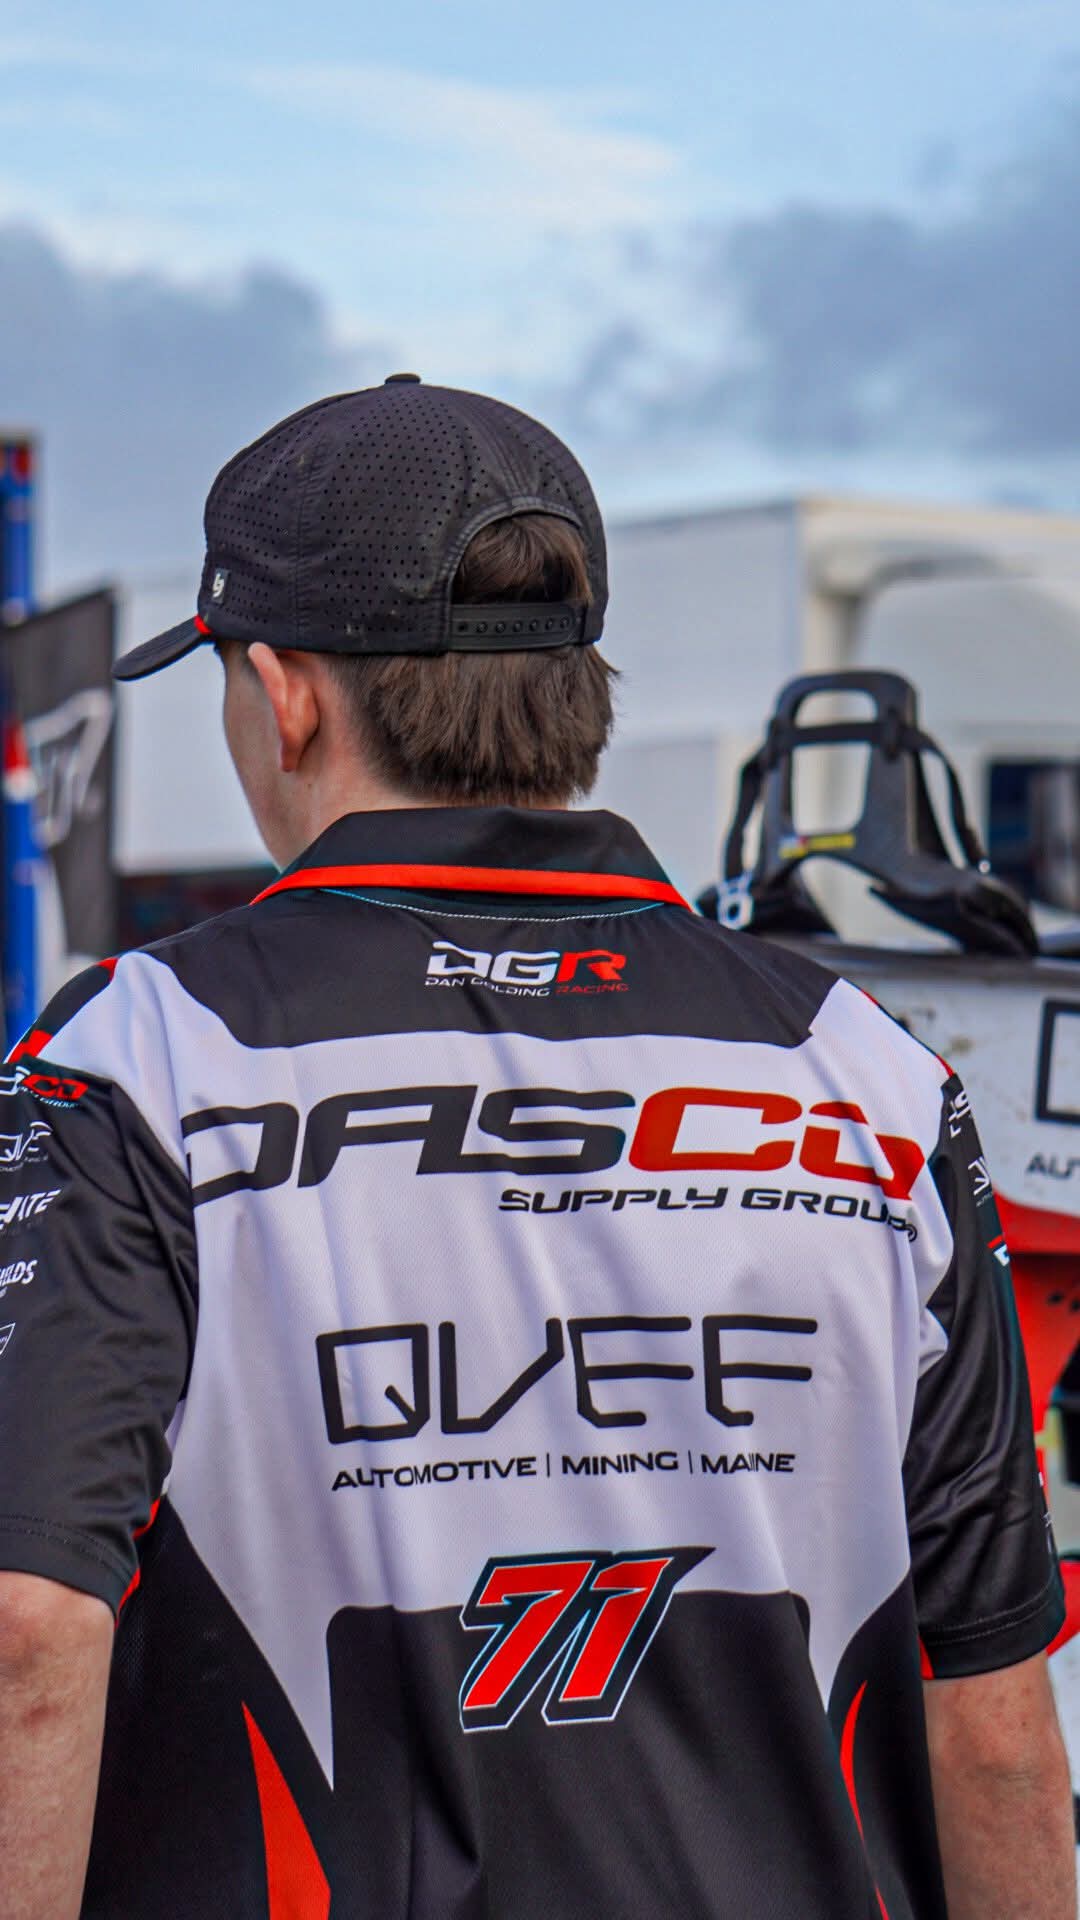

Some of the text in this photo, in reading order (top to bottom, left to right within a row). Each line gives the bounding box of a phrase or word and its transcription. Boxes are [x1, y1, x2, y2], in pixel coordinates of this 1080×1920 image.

[427, 941, 628, 985] DGR
[424, 976, 466, 987] DAN
[556, 982, 629, 995] RACING
[180, 1084, 926, 1208] DASCO
[498, 1187, 729, 1215] SUPPLY
[331, 1456, 537, 1491] AUTOMOTIVE
[561, 1451, 679, 1476] MINING
